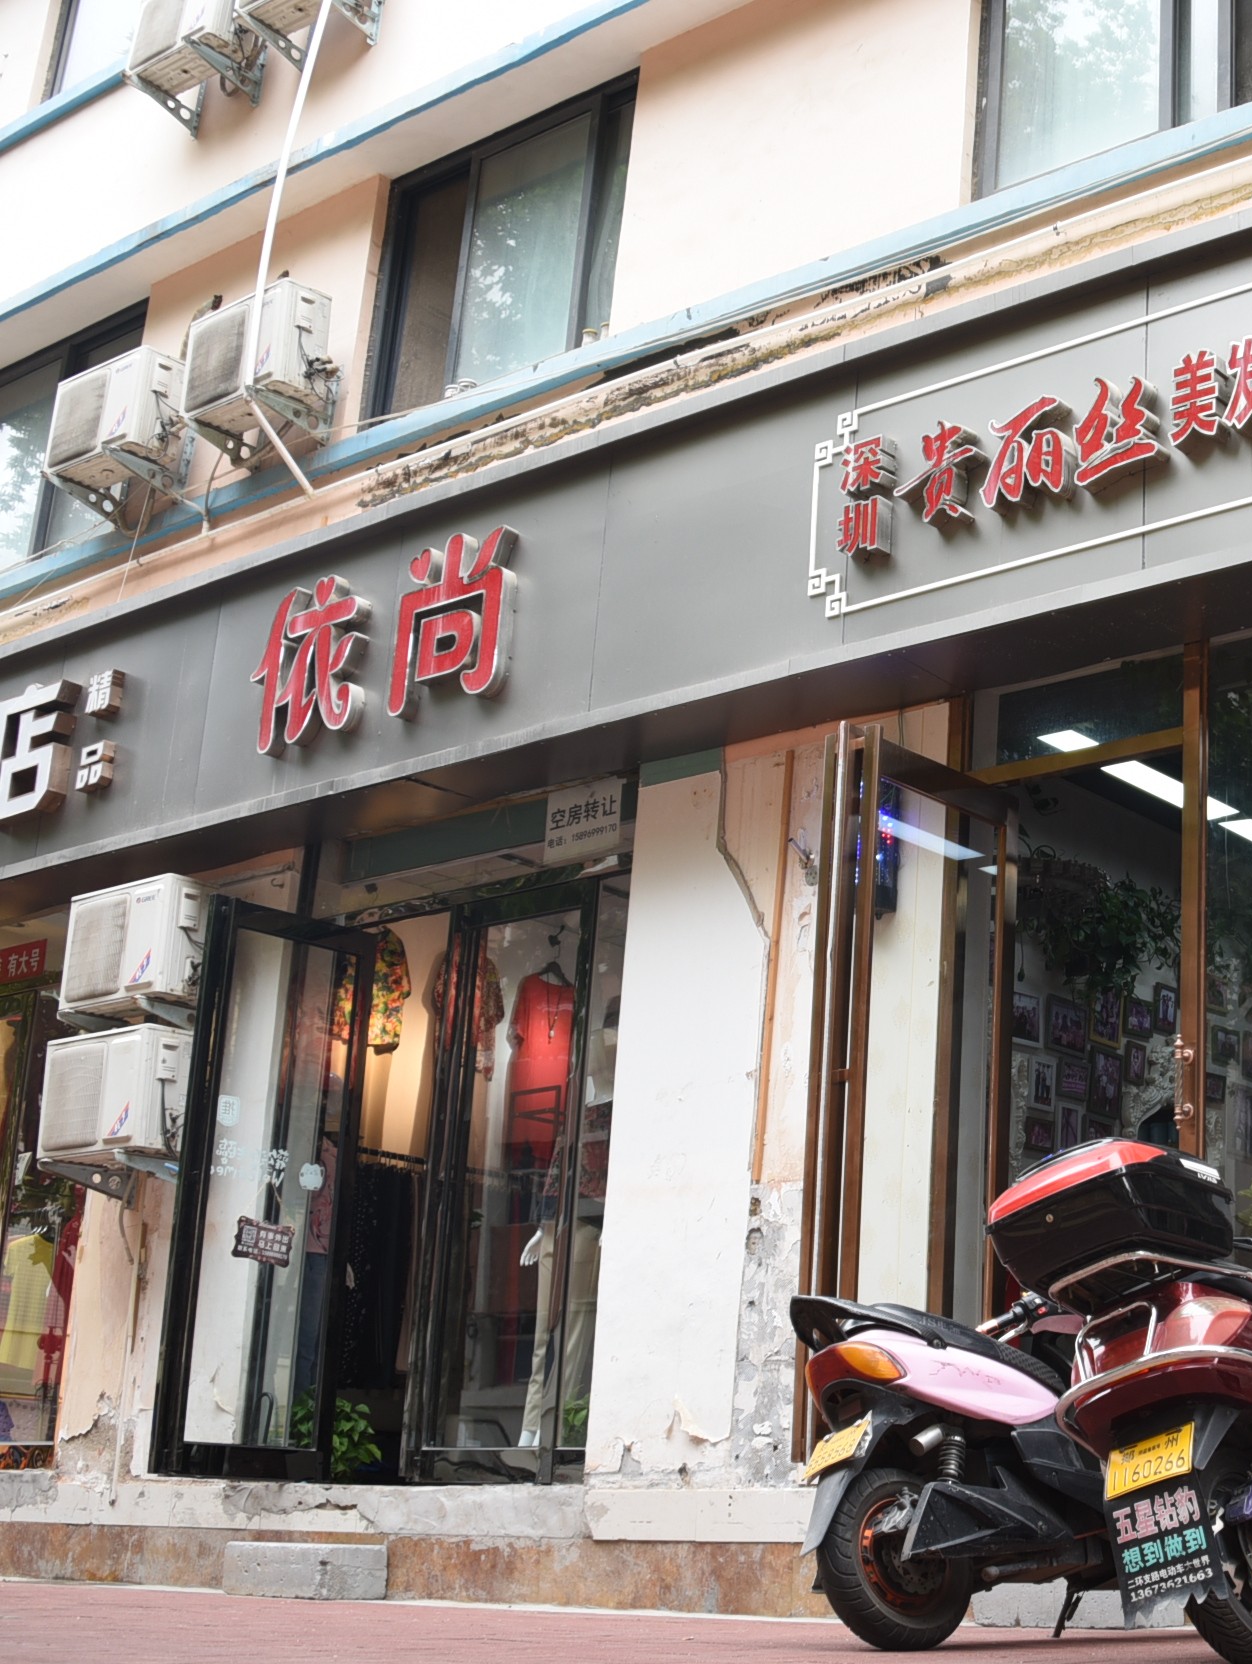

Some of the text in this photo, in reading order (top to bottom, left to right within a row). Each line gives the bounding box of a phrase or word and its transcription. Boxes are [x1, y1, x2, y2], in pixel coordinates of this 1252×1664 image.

[836, 434, 887, 557] 深圳
[893, 377, 1162, 525] 贵丽丝
[250, 525, 515, 756] 依尚
[0, 679, 64, 820] 店
[75, 670, 117, 792] 精品
[549, 794, 617, 831] 空房转让
[8, 948, 40, 977] 有大号
[1112, 1449, 1186, 1491] 1160266
[1112, 1485, 1201, 1544] 五星钻豹
[1122, 1526, 1207, 1574] 想到做到
